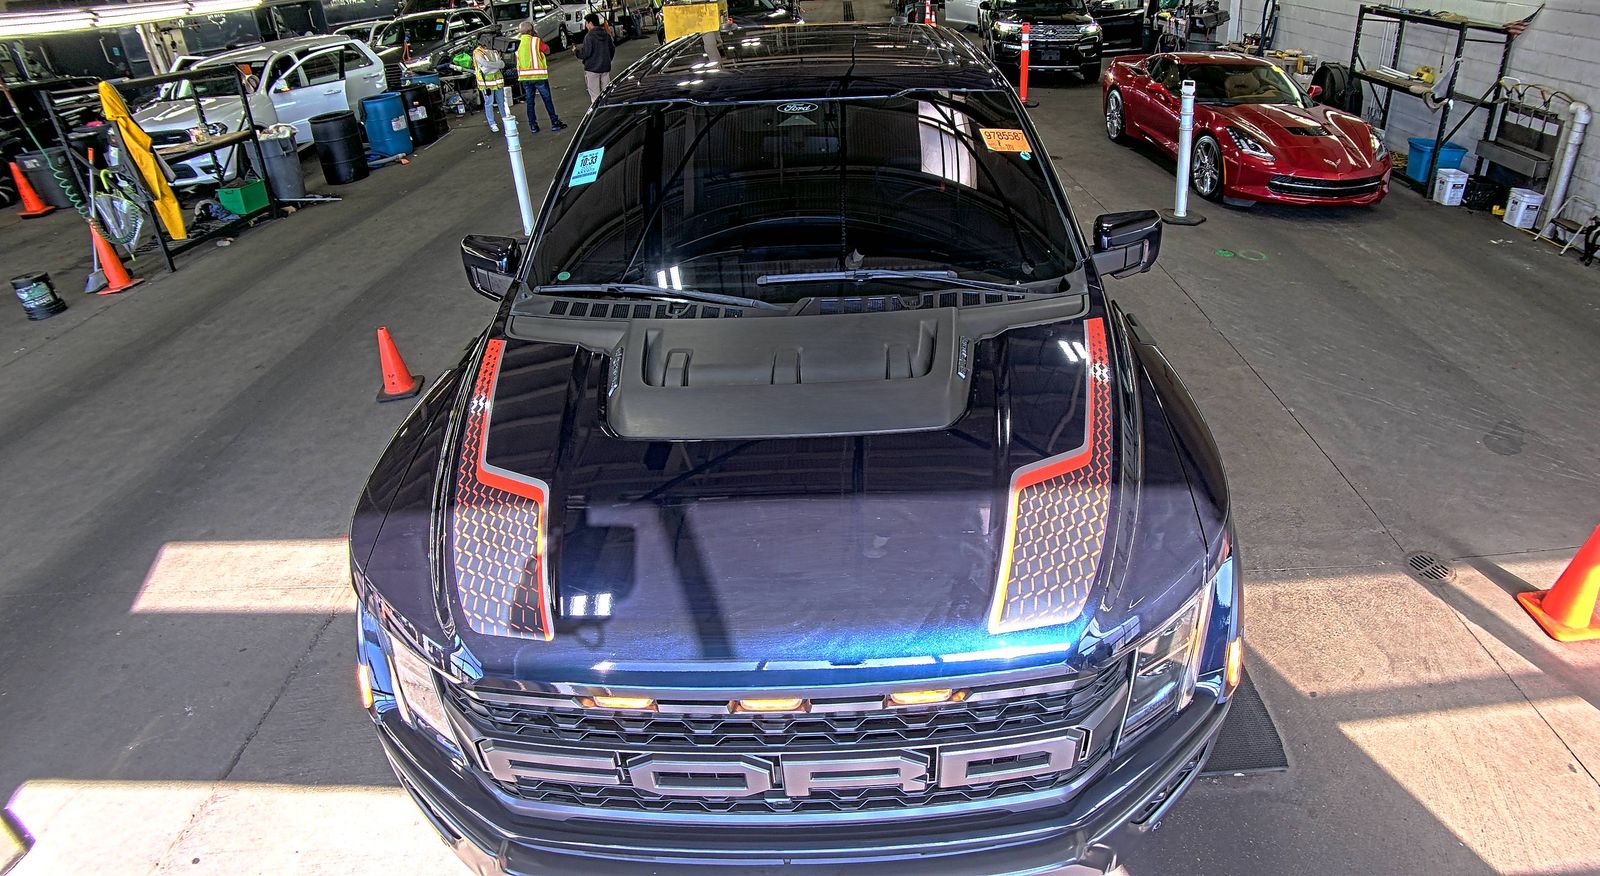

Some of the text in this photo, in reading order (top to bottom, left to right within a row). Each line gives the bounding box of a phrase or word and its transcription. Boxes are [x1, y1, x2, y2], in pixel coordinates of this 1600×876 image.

[783, 103, 812, 112] Ford
[984, 131, 1024, 141] 9785587
[580, 155, 598, 167] 10:33
[480, 730, 1082, 797] FORD
